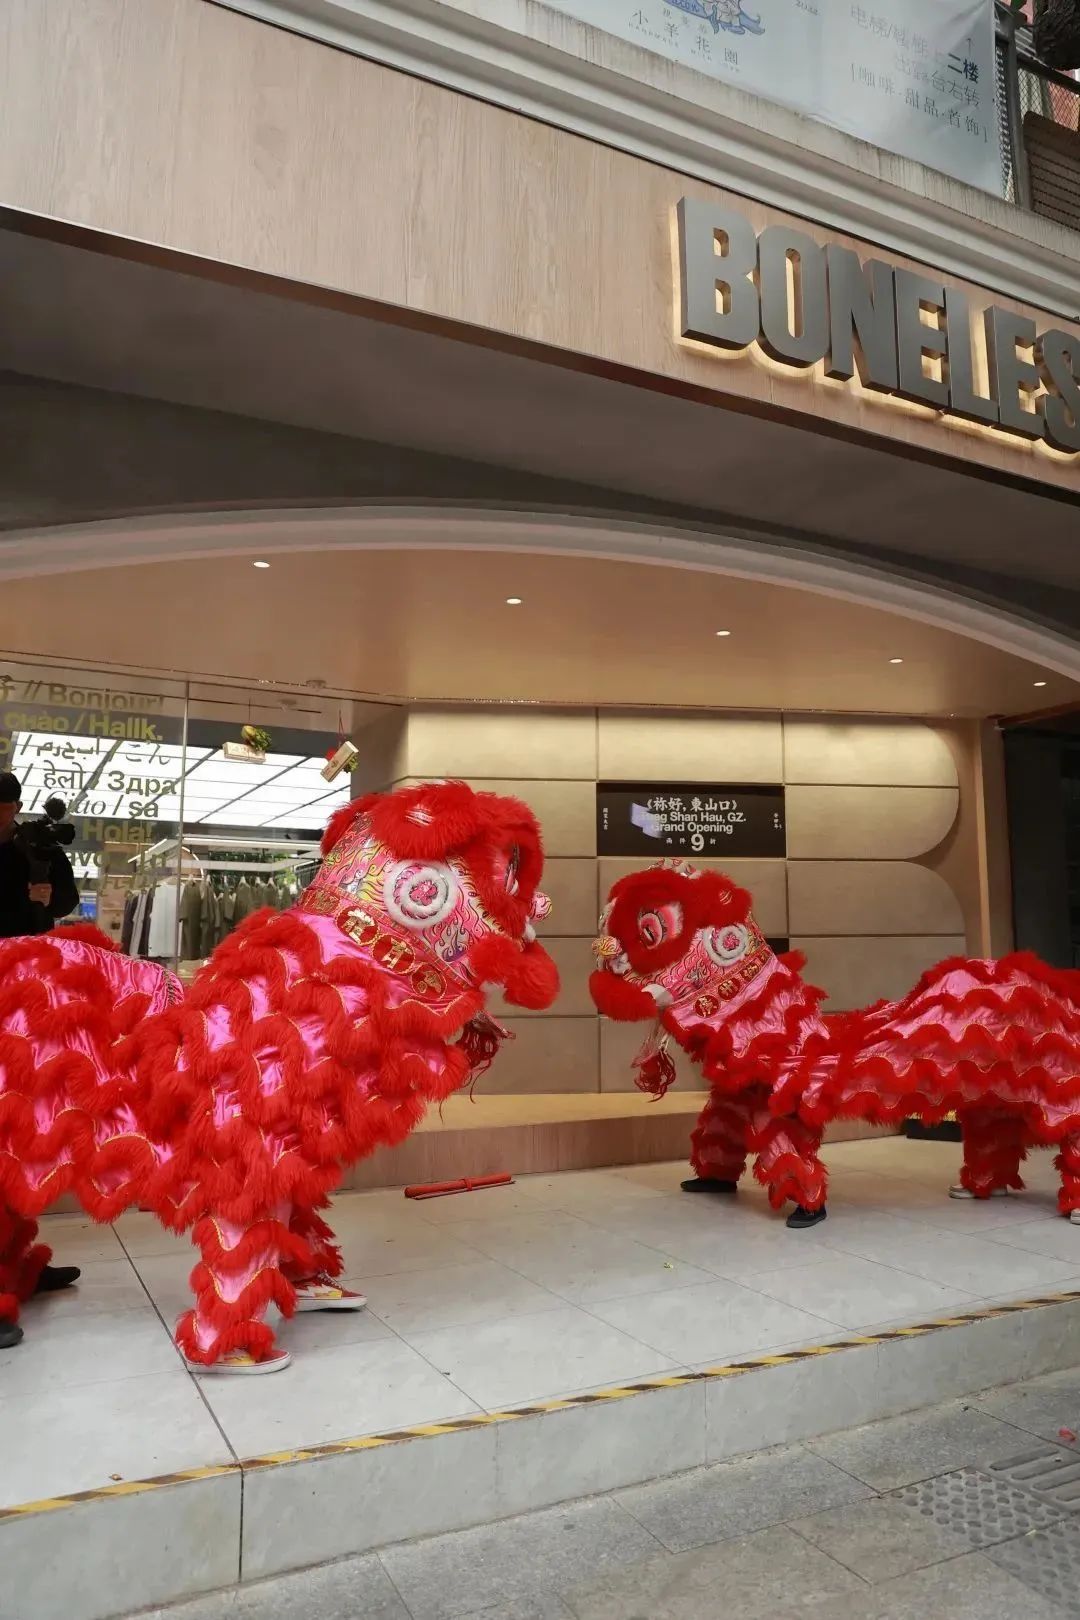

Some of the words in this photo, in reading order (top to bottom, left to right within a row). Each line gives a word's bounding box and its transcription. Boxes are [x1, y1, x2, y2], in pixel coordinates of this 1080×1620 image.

[107, 770, 177, 797] Здра
[670, 812, 698, 822] Shan
[701, 812, 726, 823] Hau,
[727, 812, 747, 822] GZ.
[687, 822, 733, 834] Opening
[691, 833, 704, 851] 9
